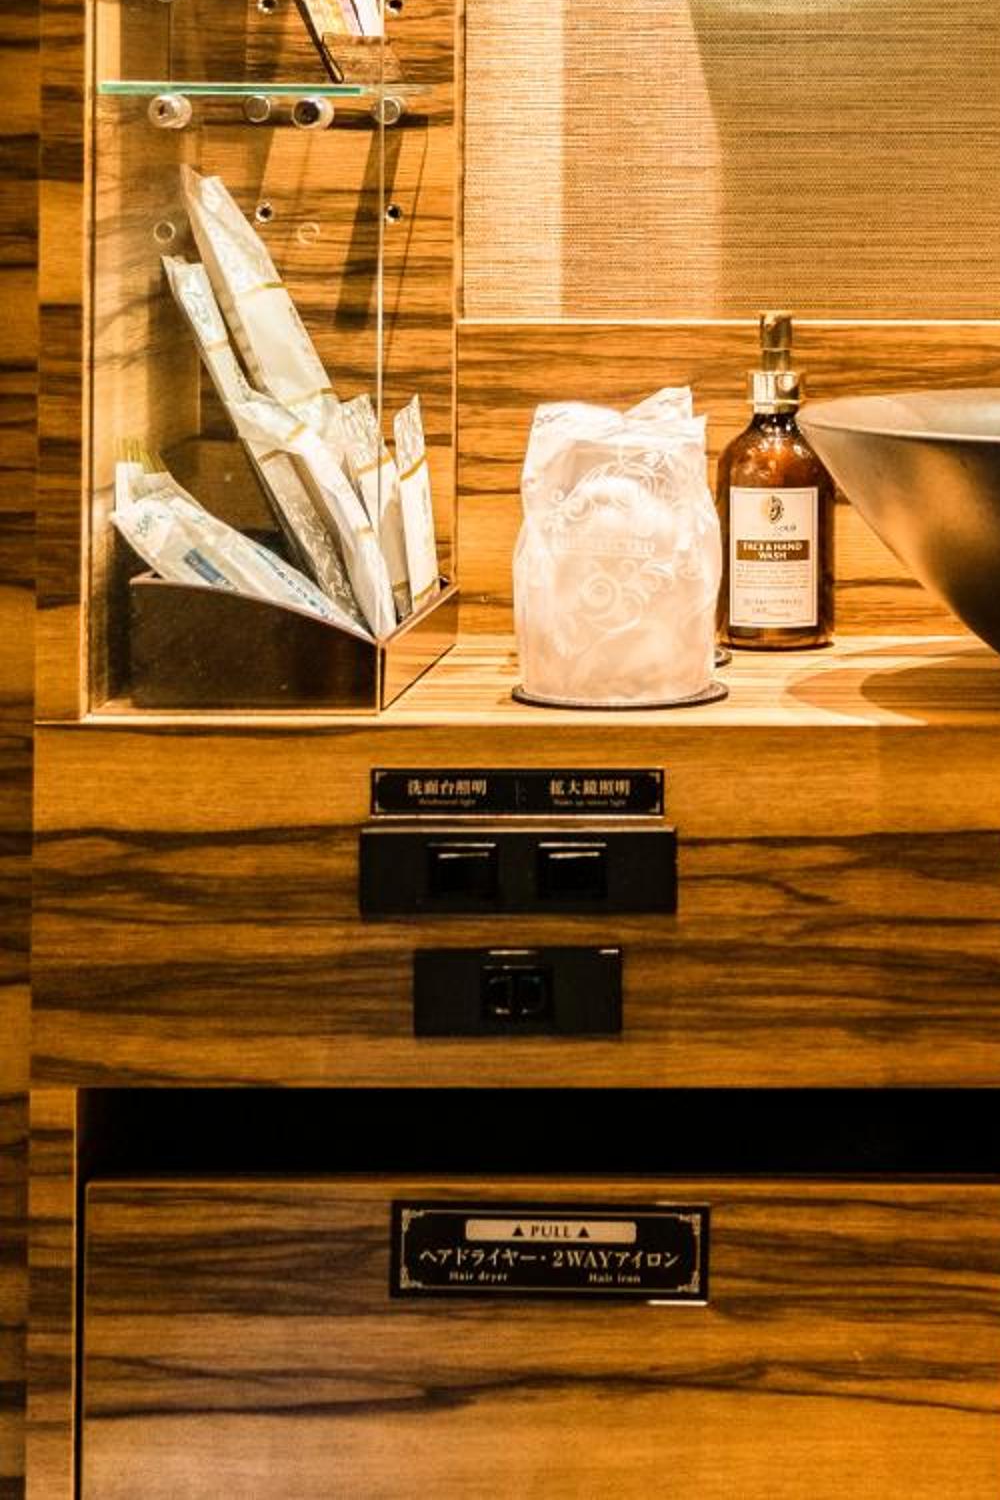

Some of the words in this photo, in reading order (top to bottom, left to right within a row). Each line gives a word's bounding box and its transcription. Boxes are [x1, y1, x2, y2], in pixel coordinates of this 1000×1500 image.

[530, 1225, 571, 1238] PULL
[449, 1271, 474, 1281] Hair
[478, 1271, 509, 1283] dryer
[588, 1273, 613, 1283] Hair
